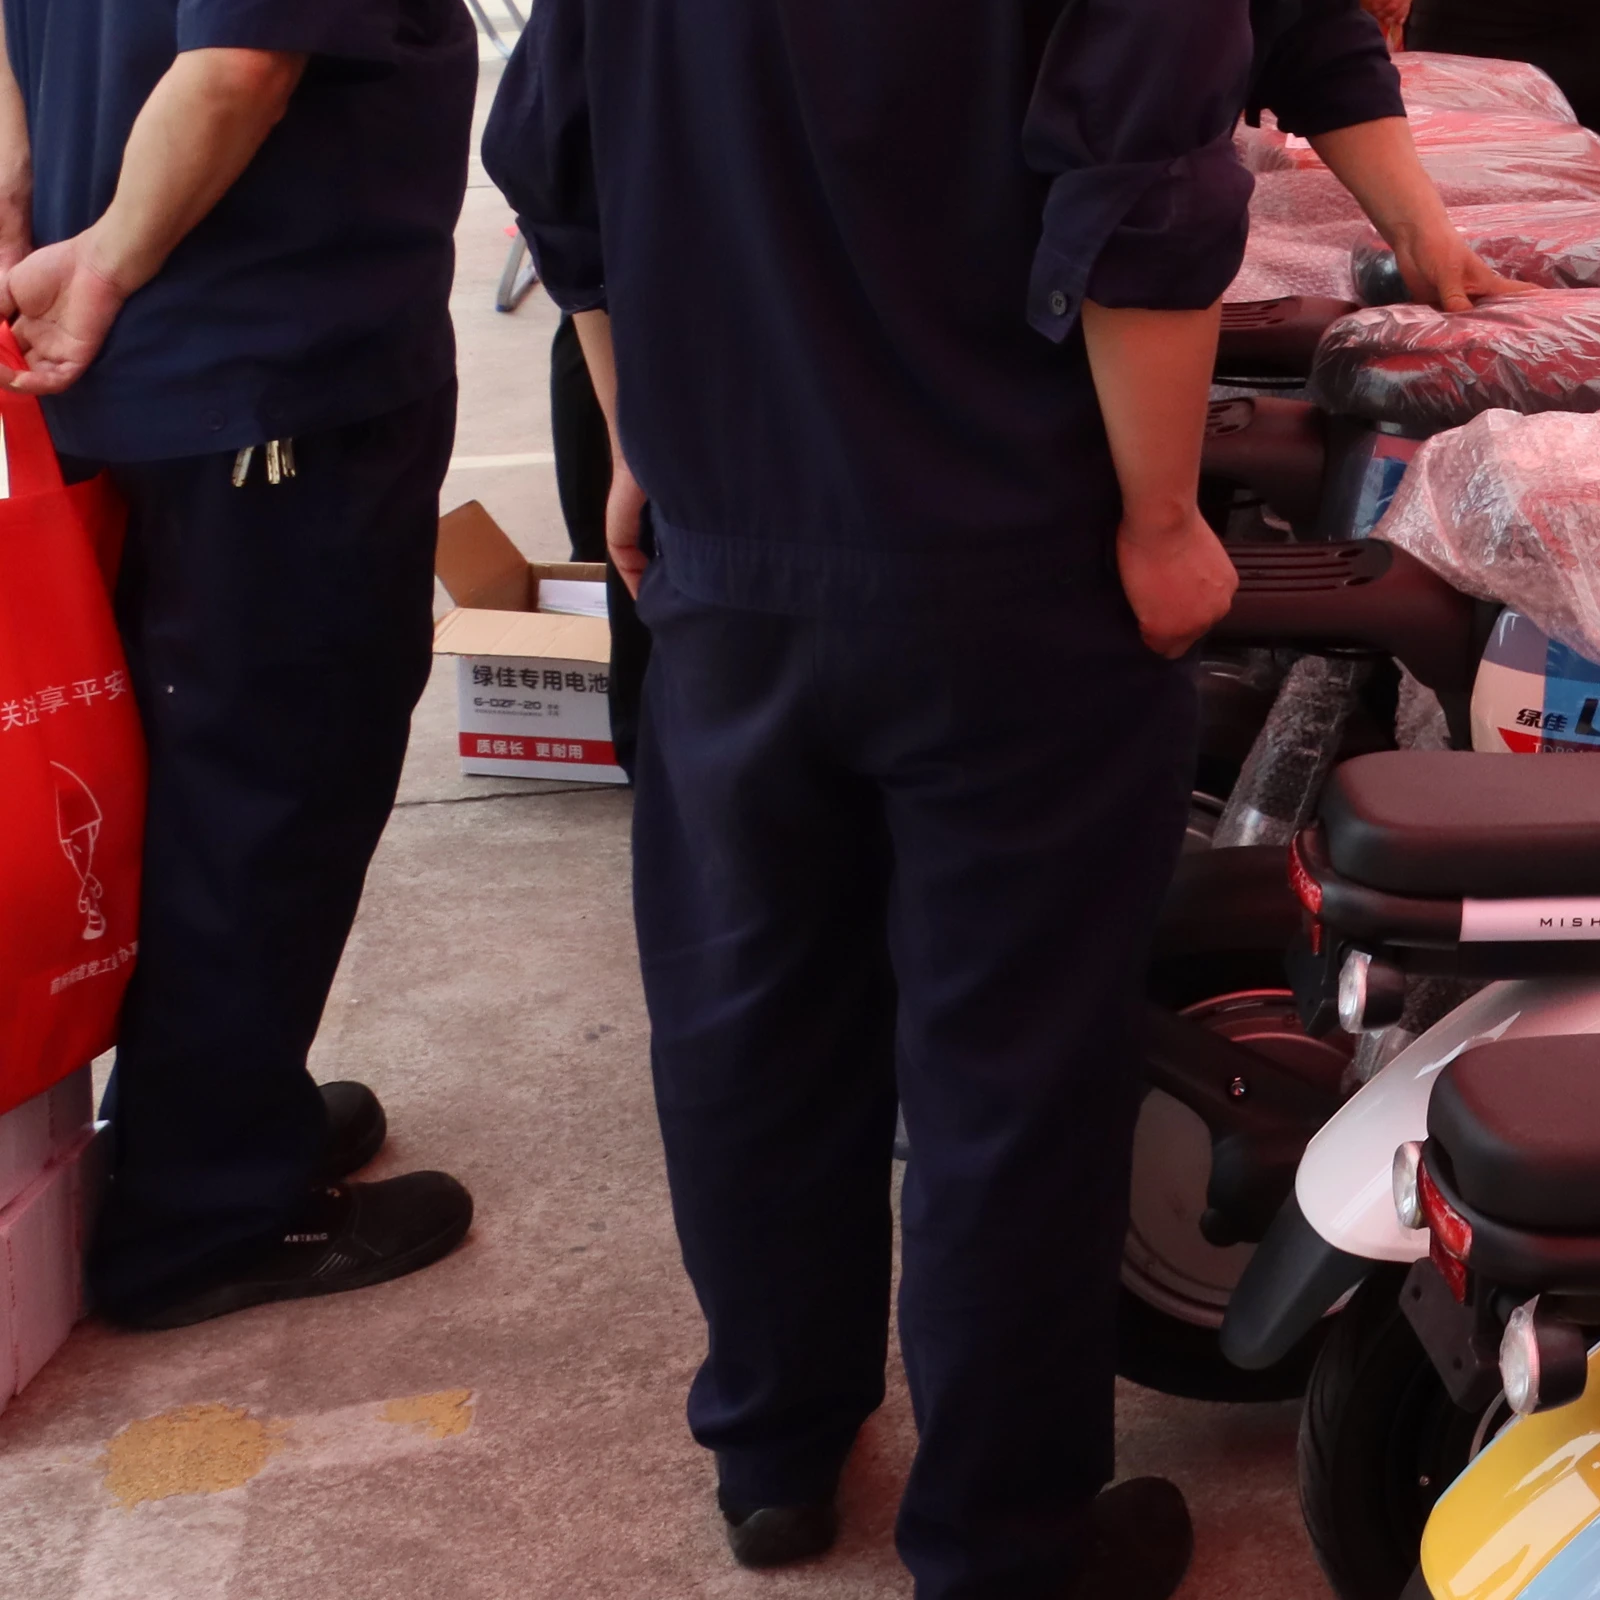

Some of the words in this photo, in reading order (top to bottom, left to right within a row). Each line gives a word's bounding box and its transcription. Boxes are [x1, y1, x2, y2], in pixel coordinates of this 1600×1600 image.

[472, 664, 610, 694] 绿佳专用电池
[1515, 708, 1568, 733] 绿佳
[476, 739, 525, 756] 质保长
